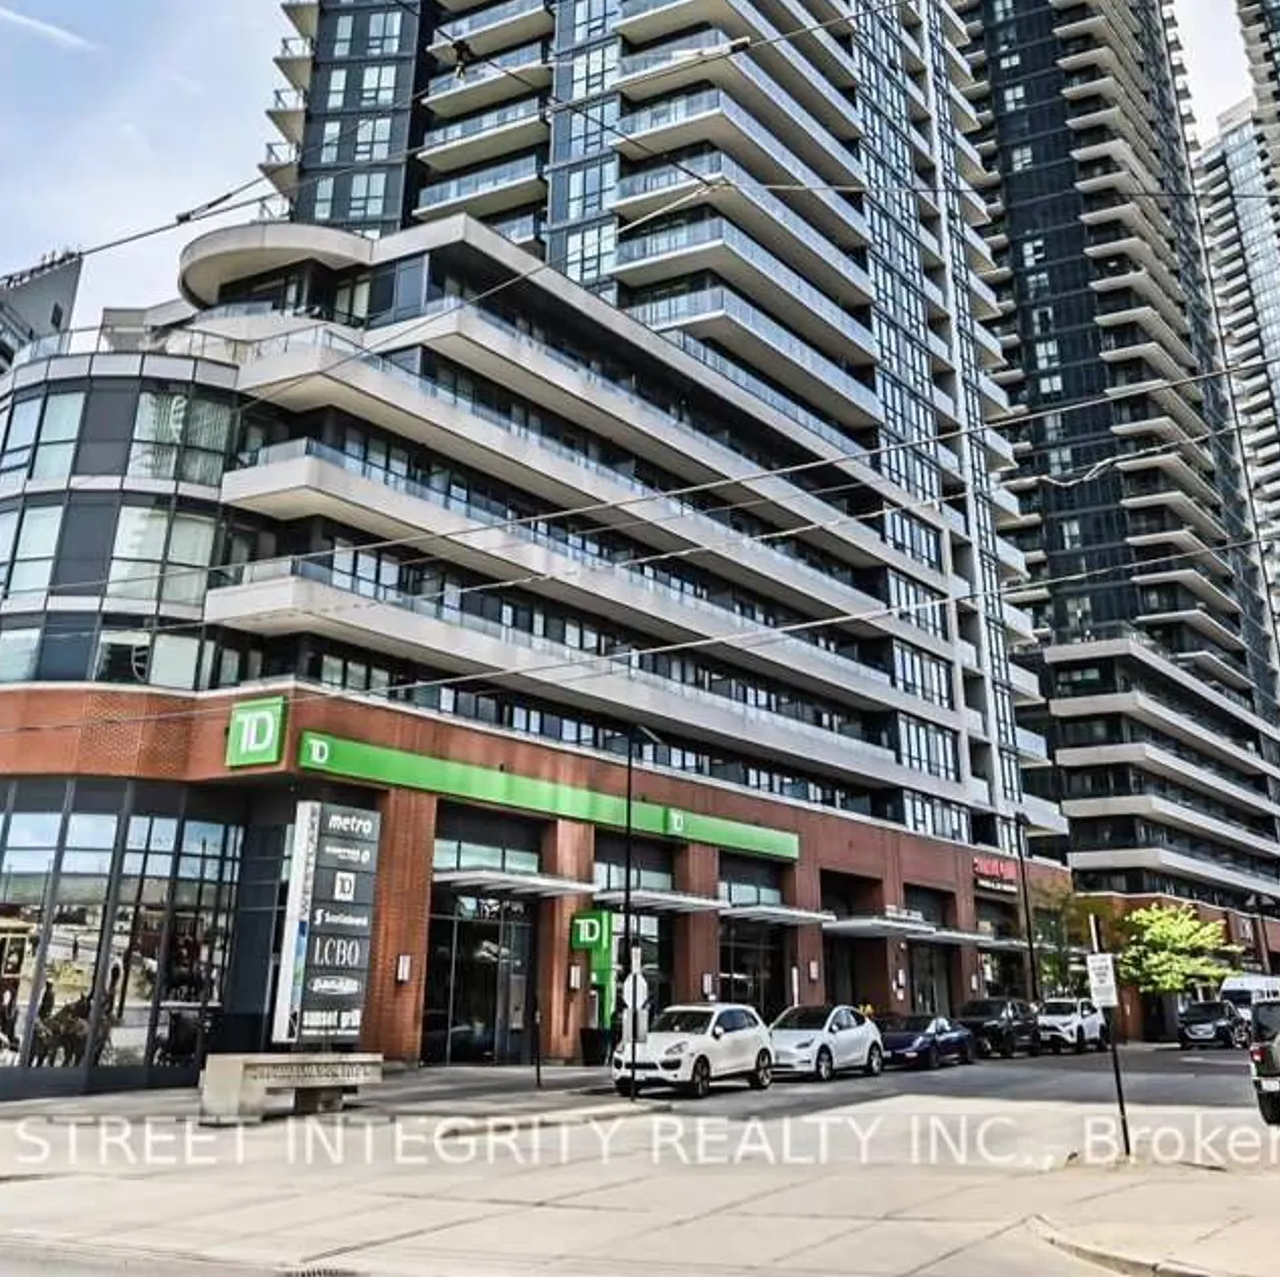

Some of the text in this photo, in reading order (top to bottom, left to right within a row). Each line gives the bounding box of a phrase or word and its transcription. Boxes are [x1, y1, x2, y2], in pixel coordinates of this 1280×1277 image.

[234, 710, 275, 755] TD
[308, 739, 329, 763] TD
[328, 814, 372, 834] metro
[573, 918, 601, 942] TD
[314, 936, 360, 967] LCBO
